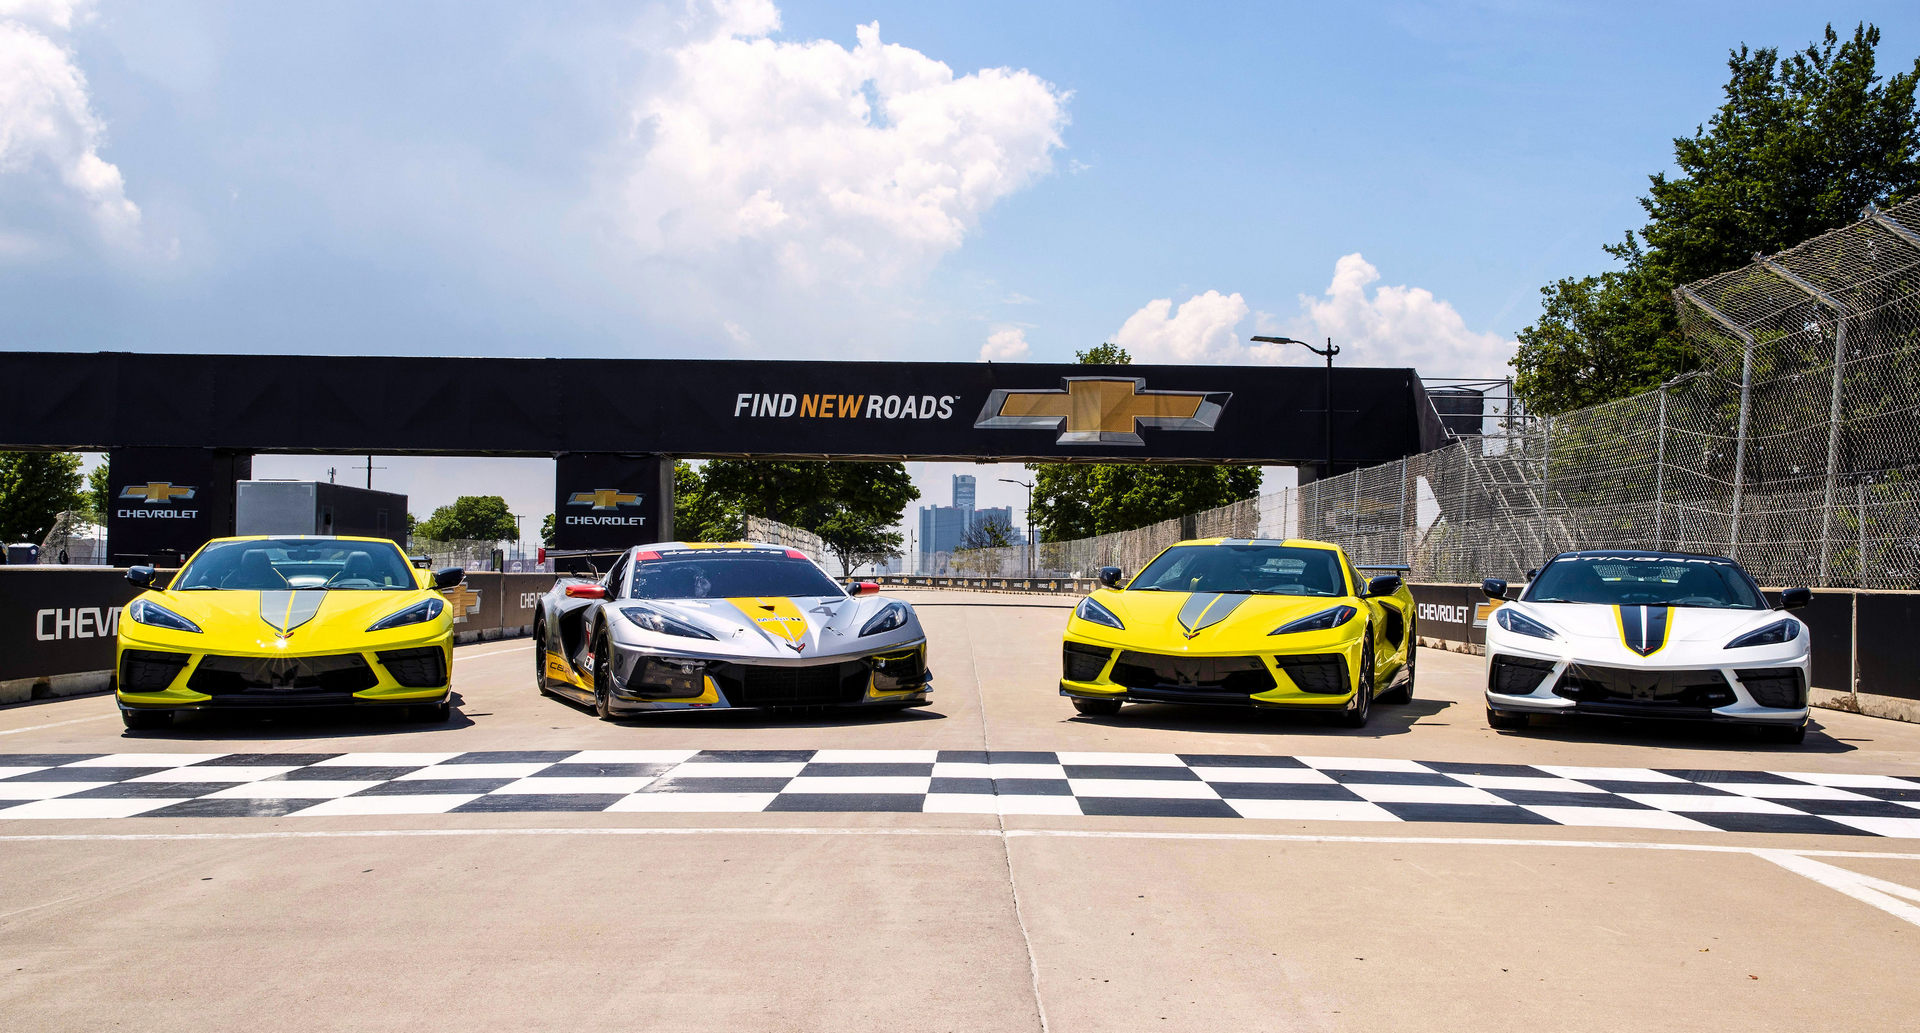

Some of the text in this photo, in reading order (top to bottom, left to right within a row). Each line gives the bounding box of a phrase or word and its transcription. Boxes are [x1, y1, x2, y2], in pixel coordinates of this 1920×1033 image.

[734, 393, 955, 420] FIND NEW ROADS
[117, 509, 199, 519] CHEVROLET
[565, 516, 646, 526] CHEVROLET
[520, 592, 547, 610] CHEV
[1418, 602, 1469, 624] CHEVROLET
